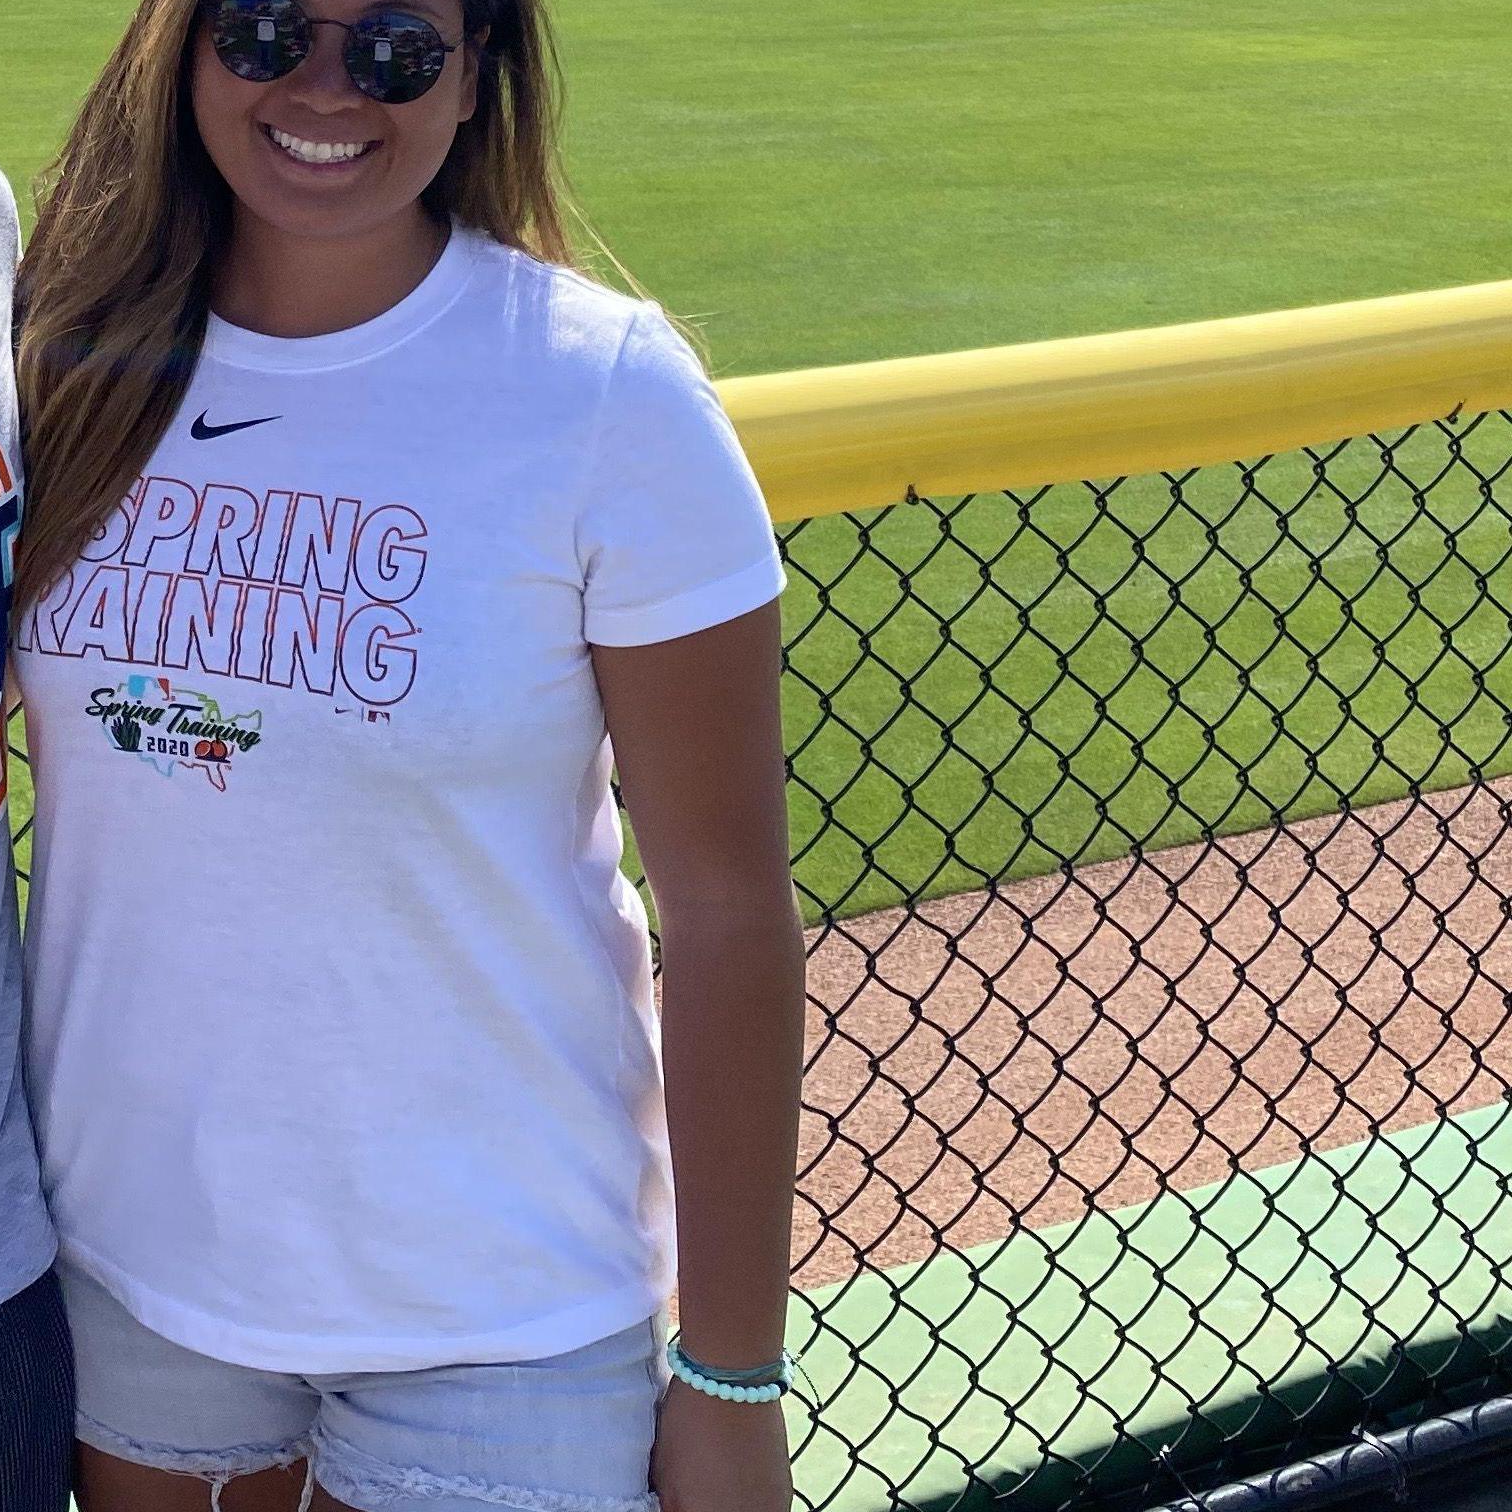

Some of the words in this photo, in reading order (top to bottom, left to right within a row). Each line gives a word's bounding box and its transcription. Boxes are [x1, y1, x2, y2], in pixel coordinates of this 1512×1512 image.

[17, 565, 419, 706] RAINING
[85, 687, 166, 727] Spring
[165, 702, 261, 753] Training
[146, 735, 190, 758] 2020
